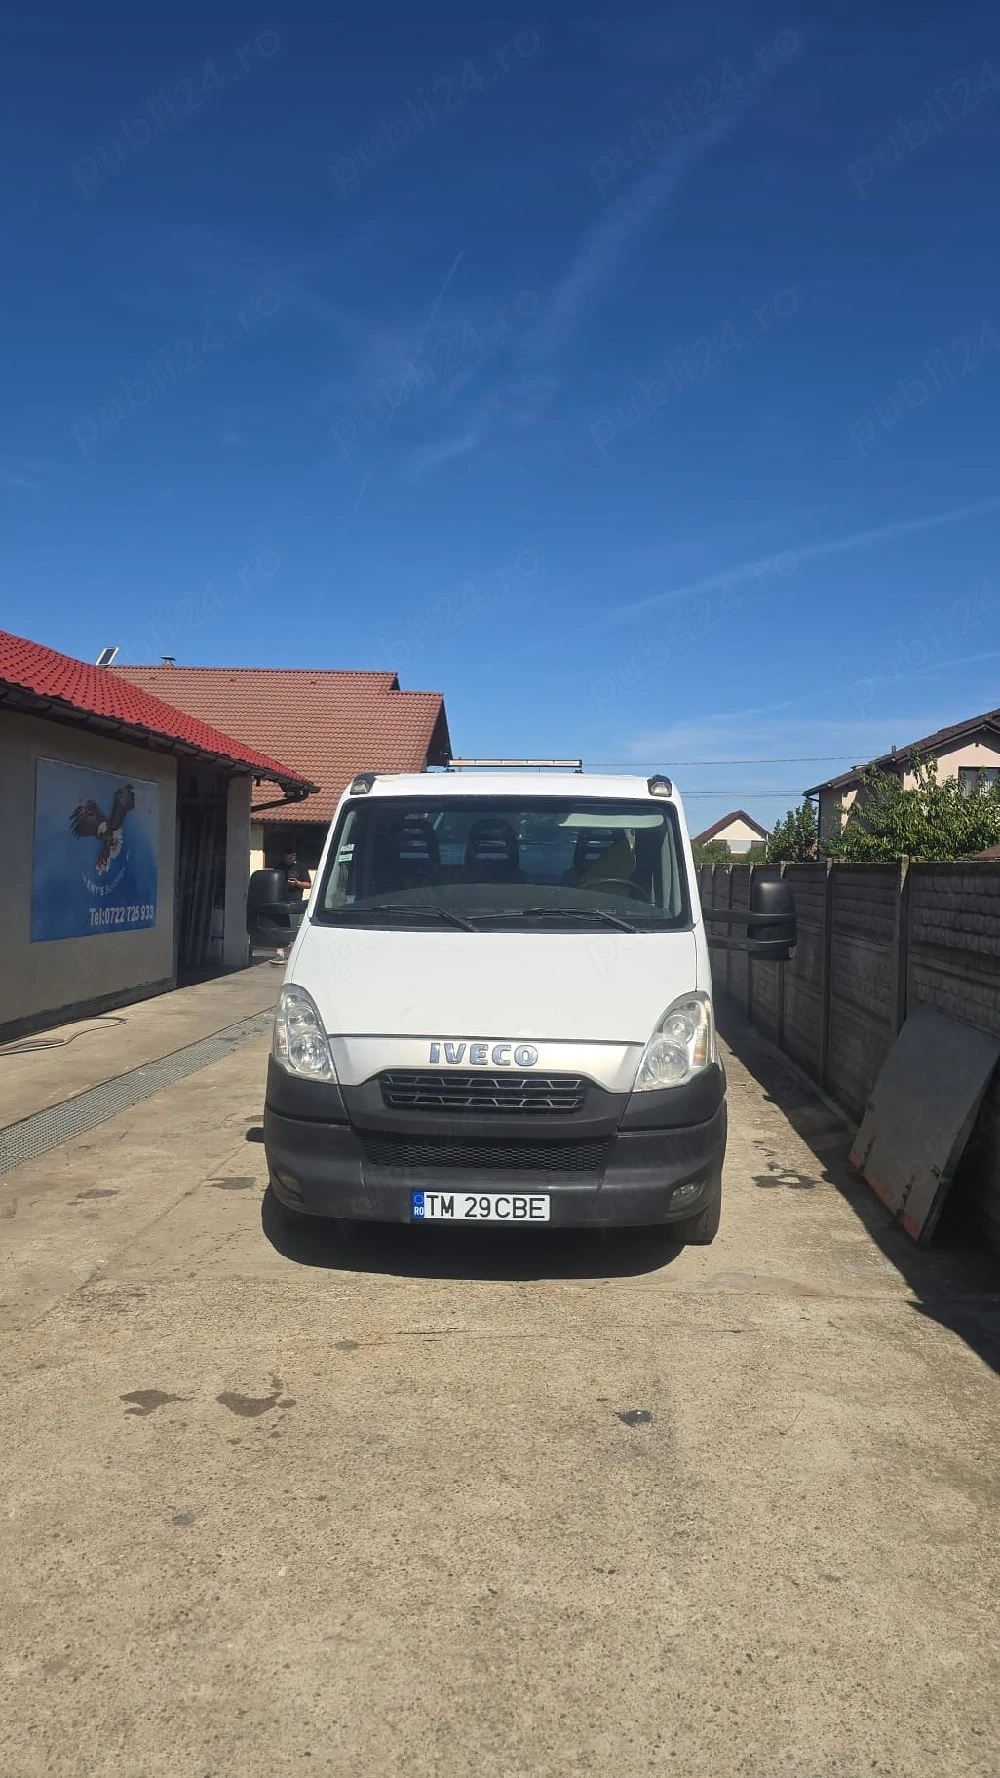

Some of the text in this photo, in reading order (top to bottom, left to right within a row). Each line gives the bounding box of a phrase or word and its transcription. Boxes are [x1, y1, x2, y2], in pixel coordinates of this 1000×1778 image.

[89, 907, 125, 926] Tel:0722
[429, 1042, 538, 1067] IVECO
[414, 1206, 424, 1216] RO
[426, 1195, 546, 1218] TM 29CBE
